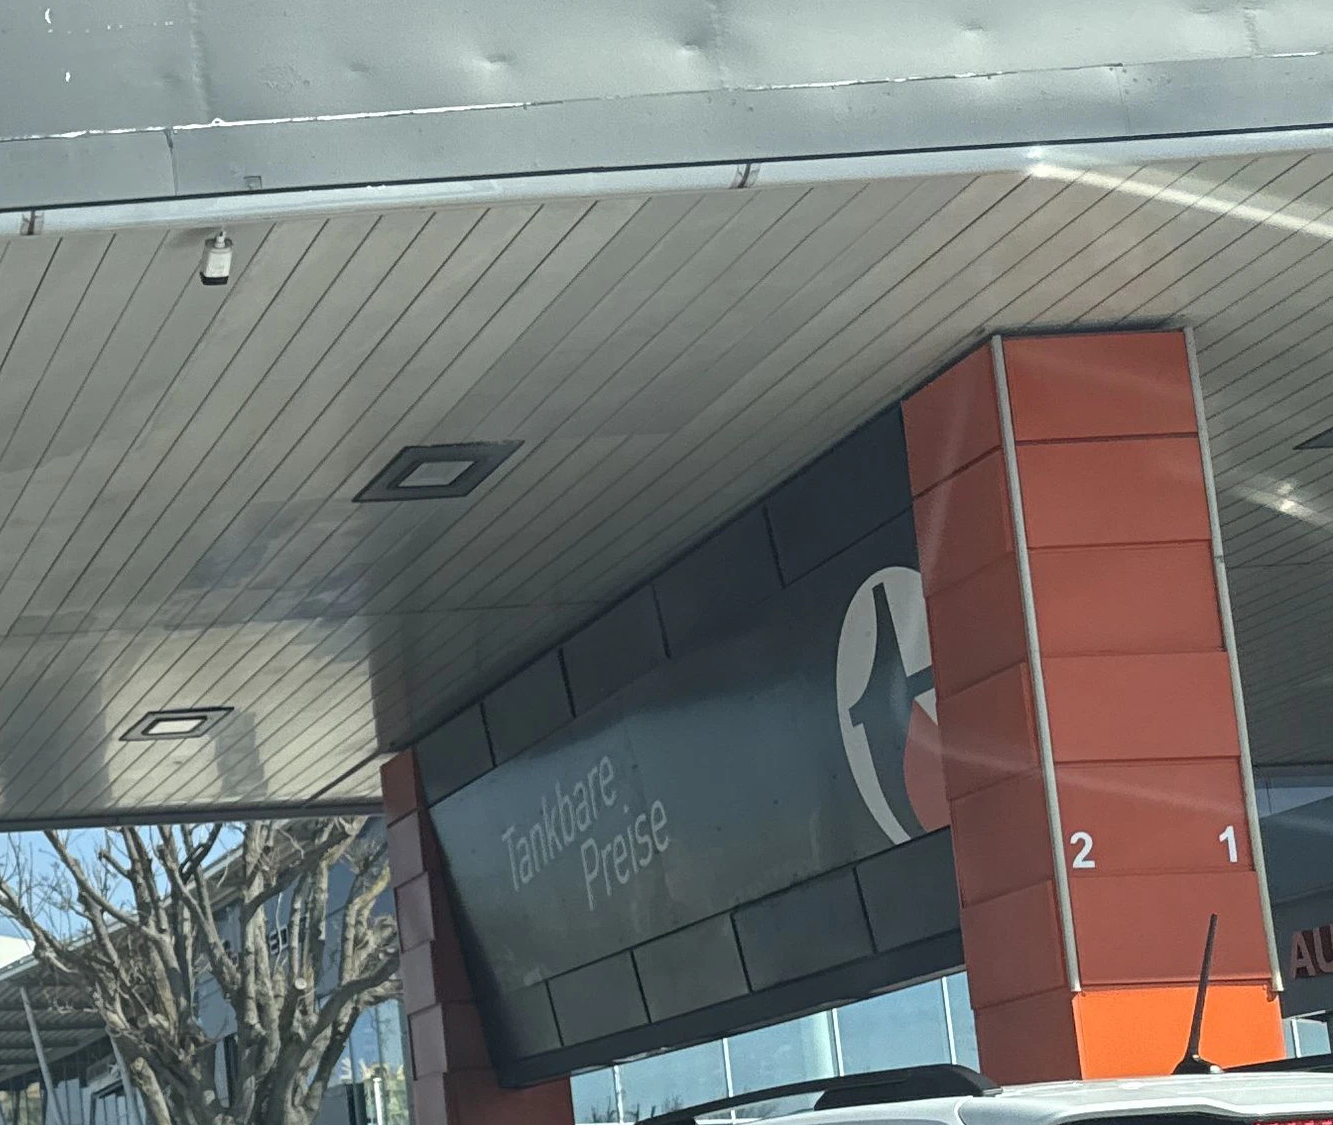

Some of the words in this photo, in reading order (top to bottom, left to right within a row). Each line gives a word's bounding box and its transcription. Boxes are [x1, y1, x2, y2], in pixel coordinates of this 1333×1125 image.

[501, 754, 617, 892] Tankbare
[579, 797, 670, 911] Preise
[1069, 831, 1096, 869] 2
[1218, 825, 1238, 864] 1
